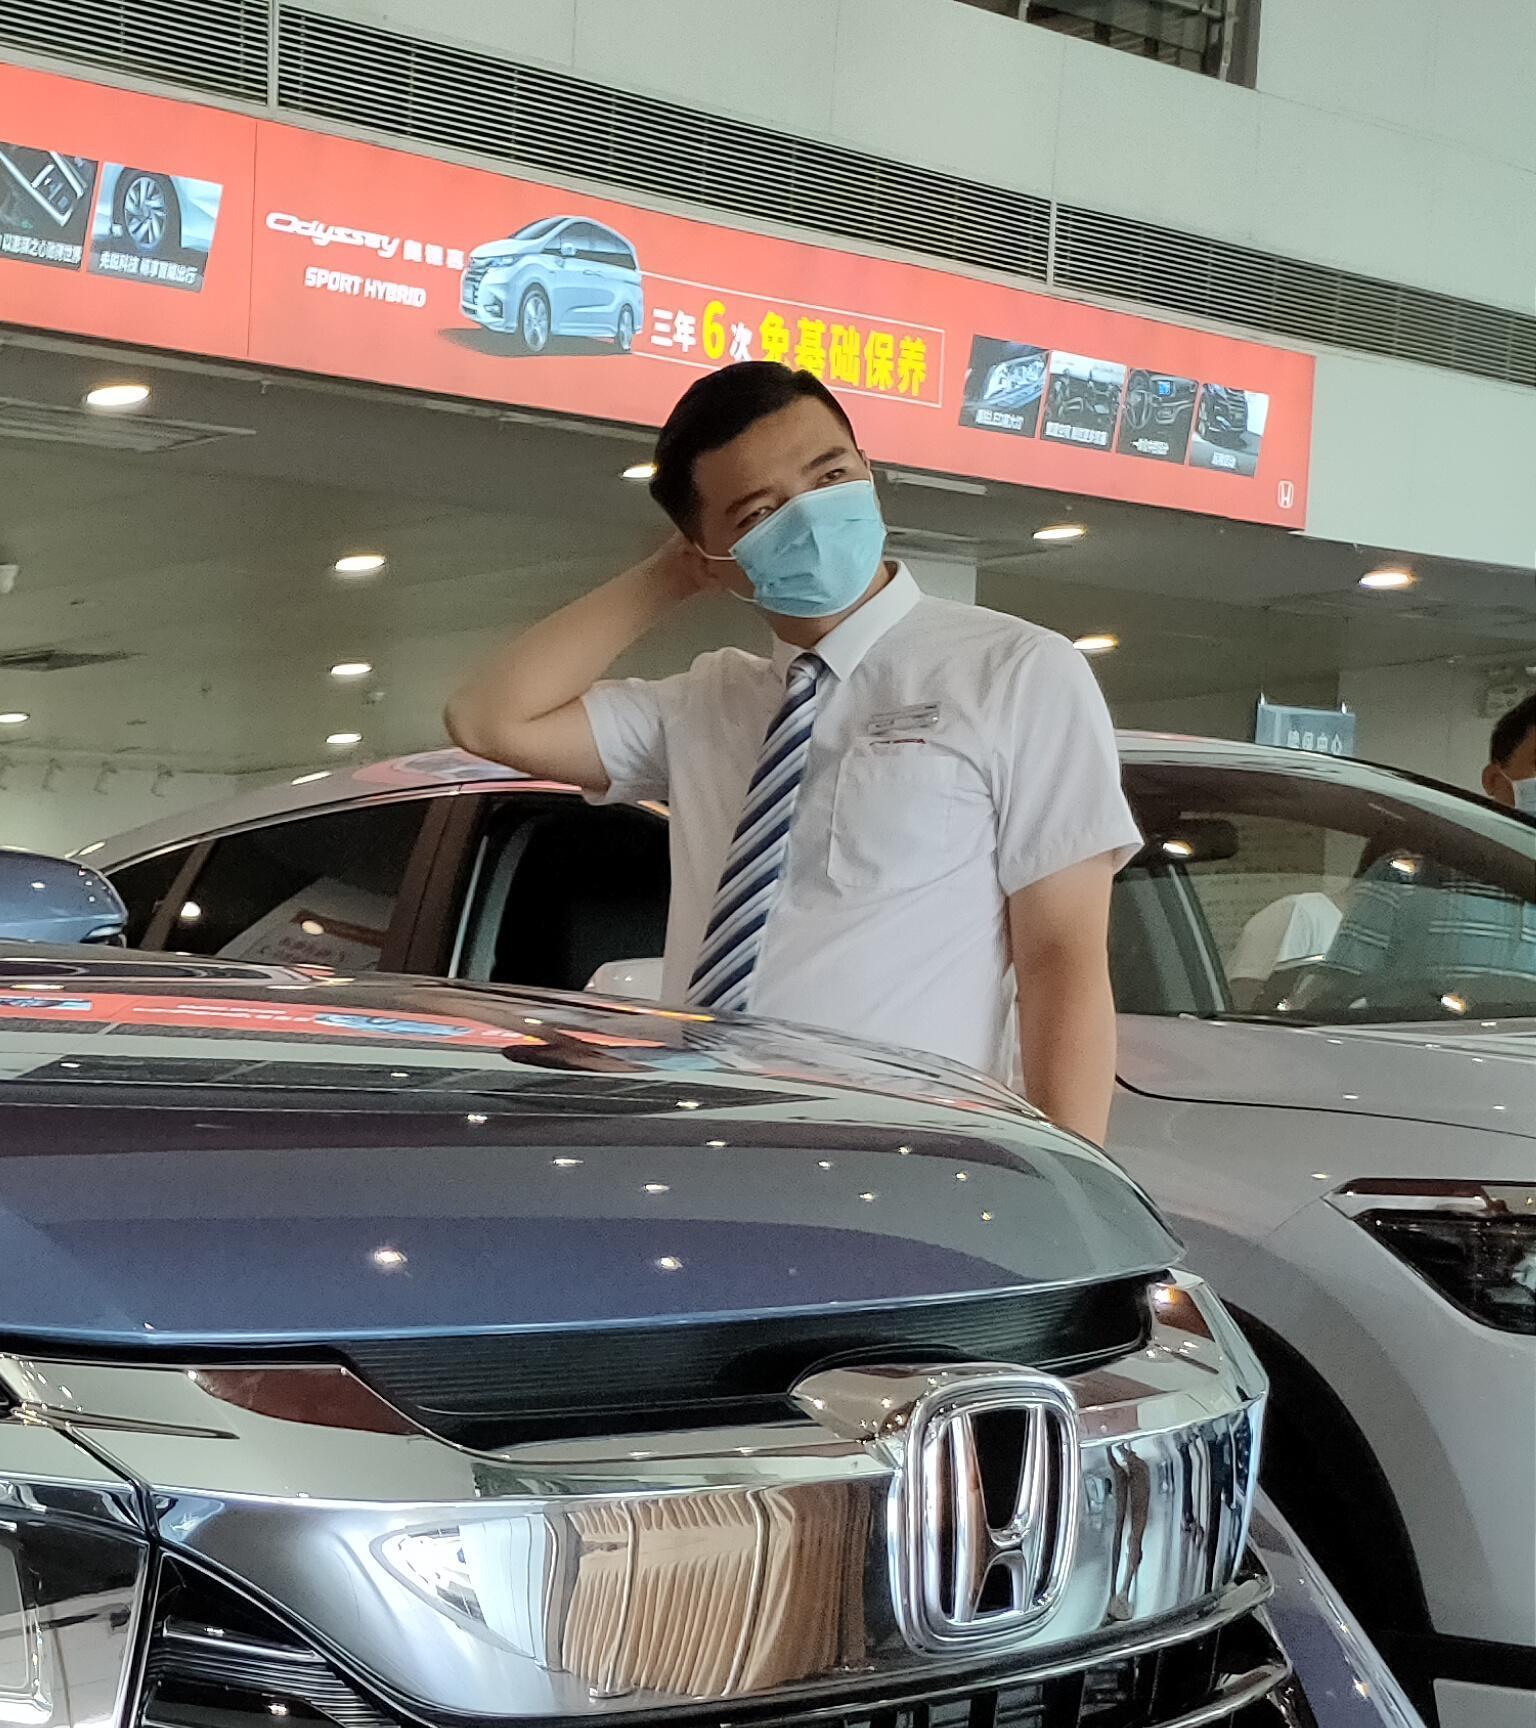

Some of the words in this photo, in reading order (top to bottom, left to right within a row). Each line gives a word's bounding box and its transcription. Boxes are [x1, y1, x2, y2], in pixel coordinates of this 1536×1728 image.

[265, 212, 400, 259] Odyssey
[303, 266, 364, 296] SPORT
[363, 278, 427, 308] HYBRID
